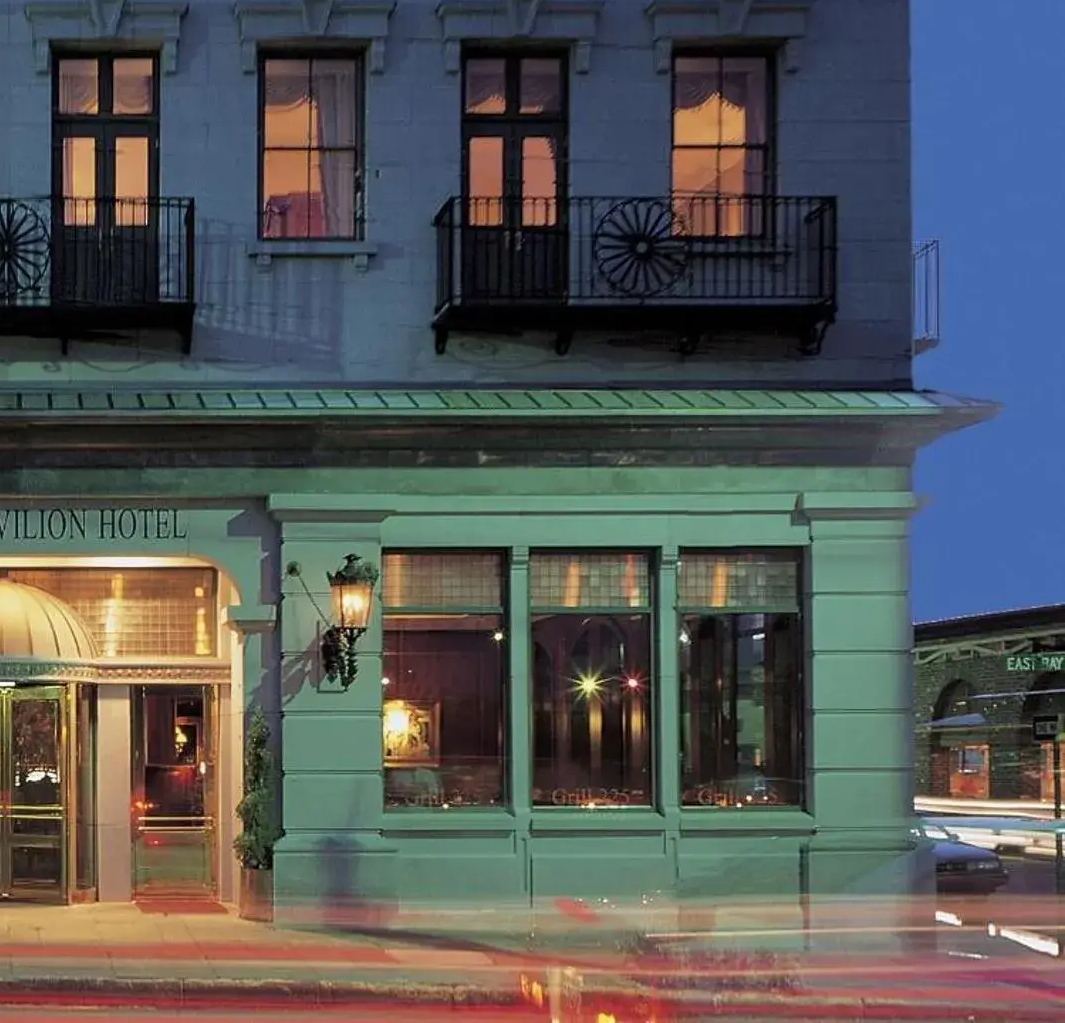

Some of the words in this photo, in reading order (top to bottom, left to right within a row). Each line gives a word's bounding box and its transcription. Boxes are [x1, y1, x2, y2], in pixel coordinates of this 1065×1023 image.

[98, 508, 187, 540] HOTEL
[1006, 657, 1035, 671] EAST
[551, 787, 592, 805] Grill
